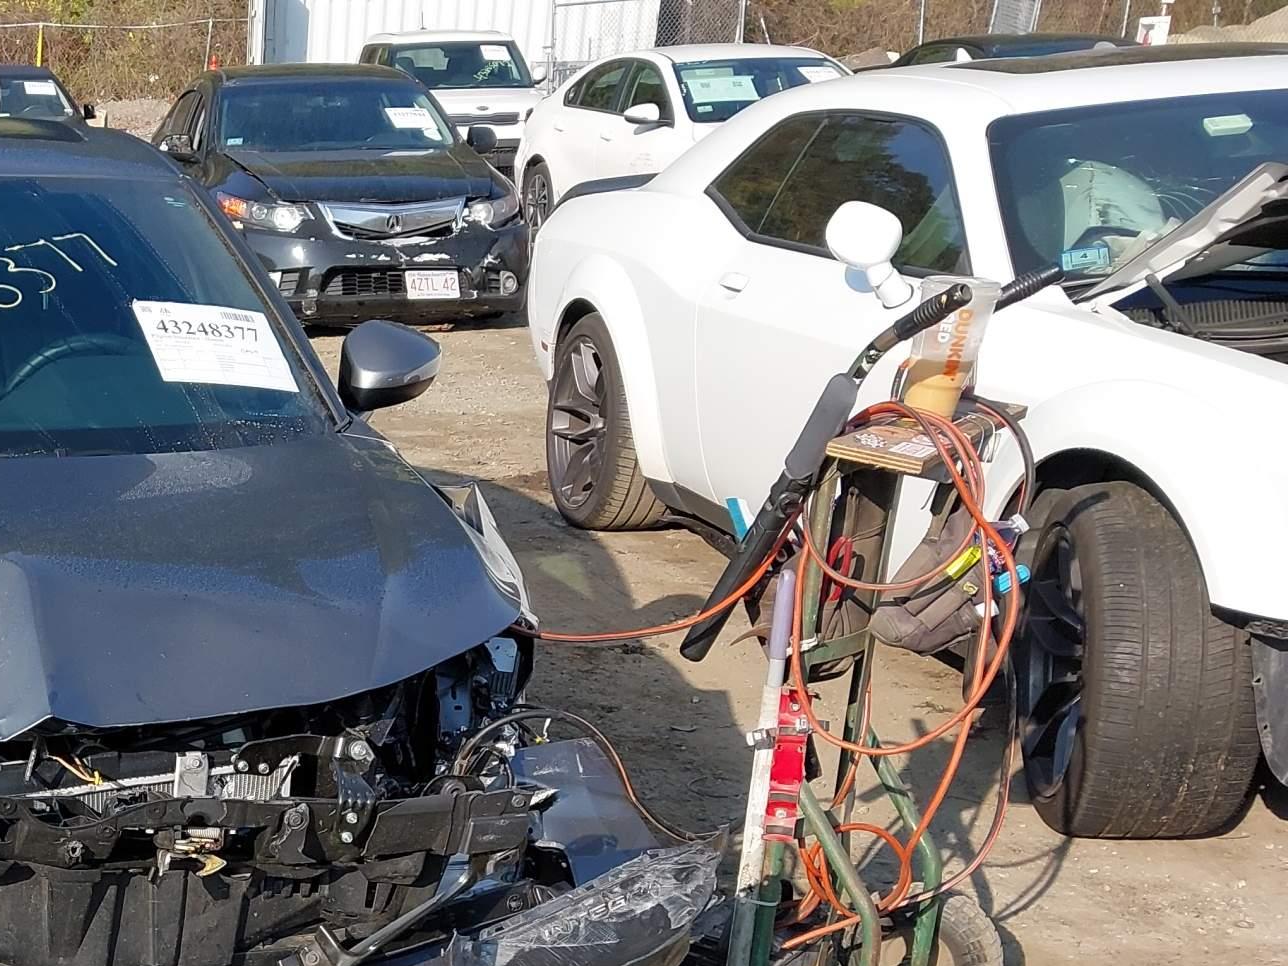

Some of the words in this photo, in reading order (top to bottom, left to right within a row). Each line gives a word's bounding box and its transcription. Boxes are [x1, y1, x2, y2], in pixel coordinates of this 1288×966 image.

[410, 277, 439, 291] 4ZTL
[442, 277, 457, 291] 42
[155, 319, 258, 342] 43248377
